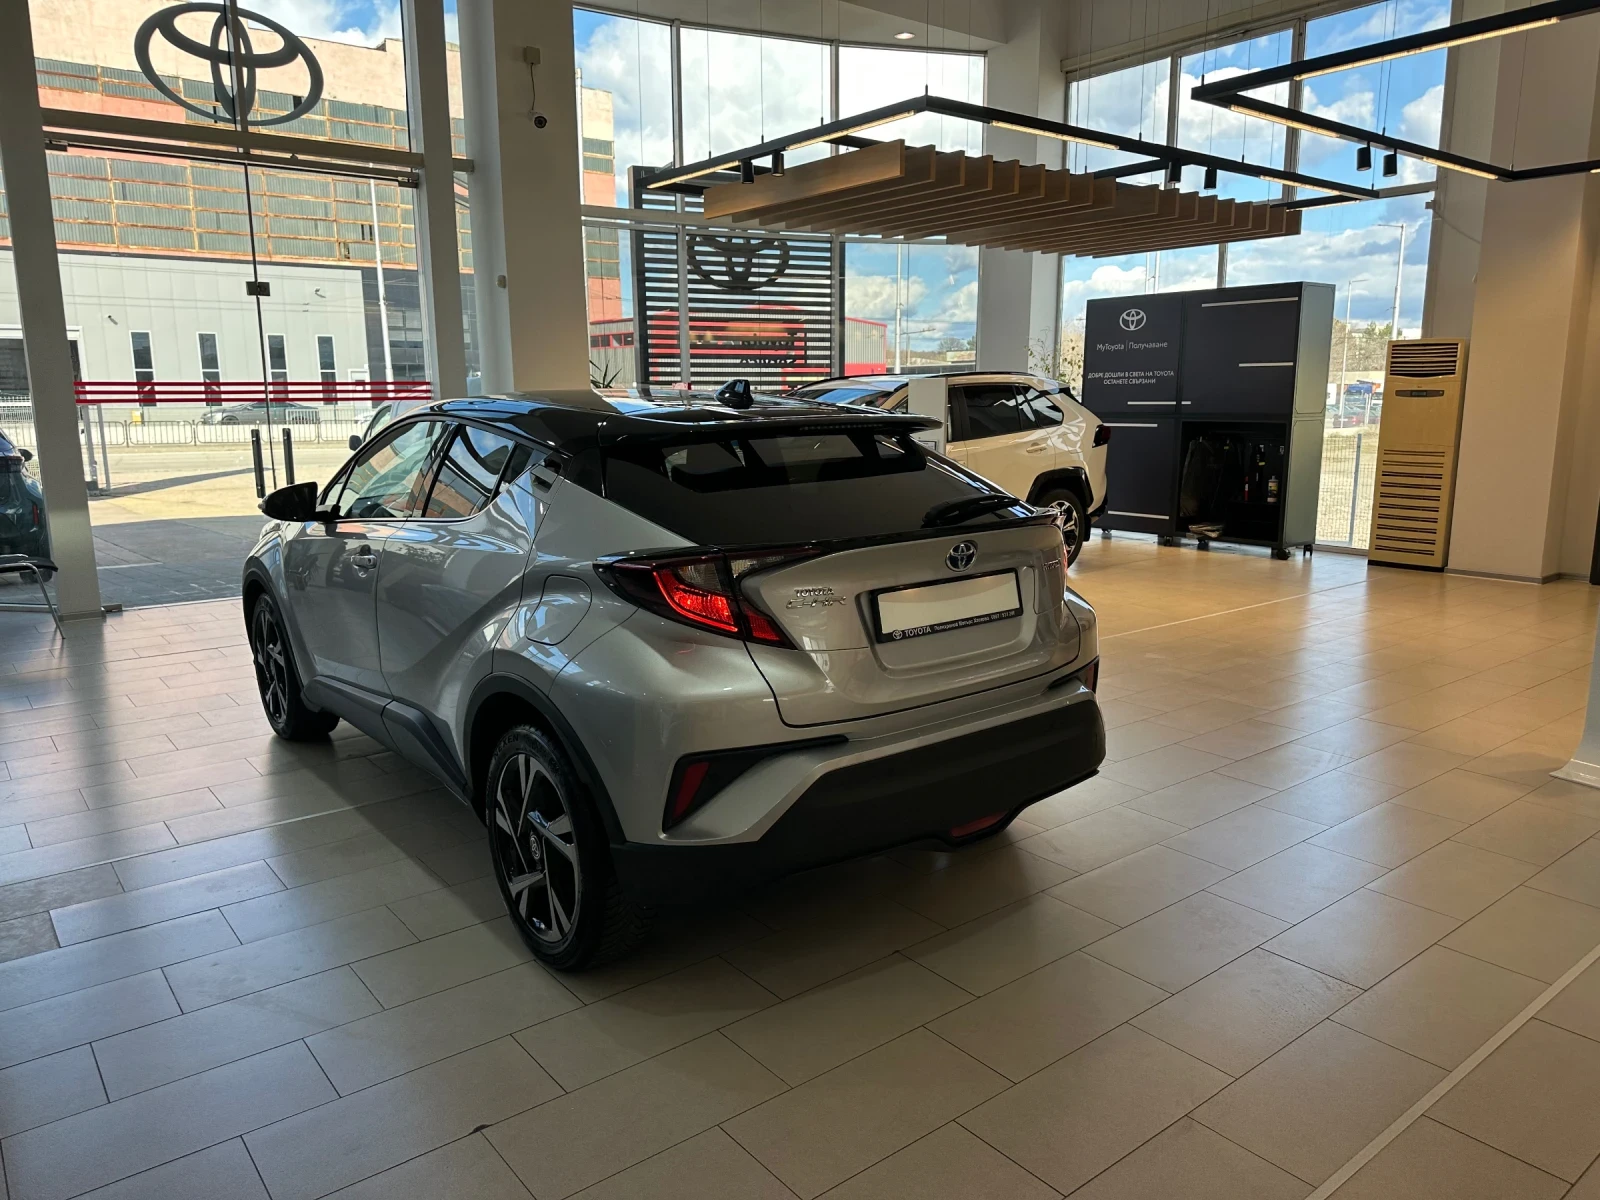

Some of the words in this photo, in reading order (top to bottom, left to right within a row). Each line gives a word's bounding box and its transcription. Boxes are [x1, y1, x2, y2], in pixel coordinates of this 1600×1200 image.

[1096, 343, 1124, 352] MyToyota
[1128, 341, 1168, 350] Получаване
[794, 586, 834, 598] TOYOTA
[786, 596, 846, 609] C-HR
[904, 626, 932, 637] TOYOTA
[492, 734, 519, 758] NEXEN
